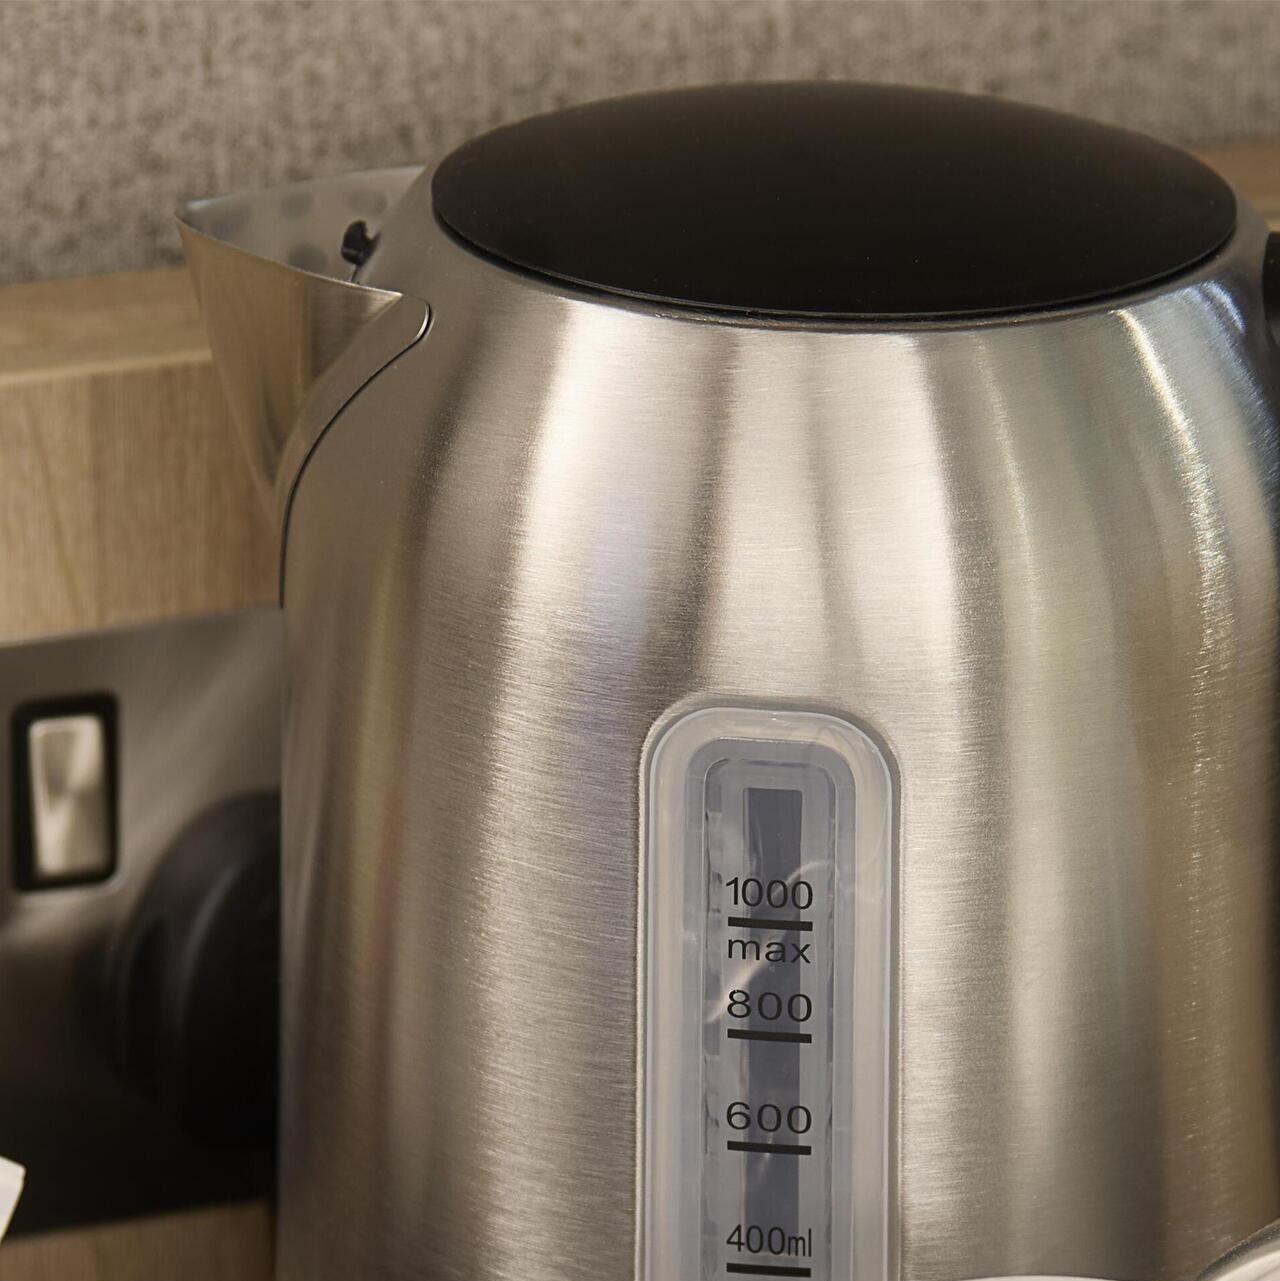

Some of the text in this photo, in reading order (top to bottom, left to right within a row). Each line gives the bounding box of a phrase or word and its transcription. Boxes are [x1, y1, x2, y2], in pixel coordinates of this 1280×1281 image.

[725, 876, 813, 911] 1000
[726, 938, 811, 964] max
[726, 989, 812, 1023] 800
[726, 1102, 812, 1135] 600
[726, 1224, 812, 1258] 400ml
